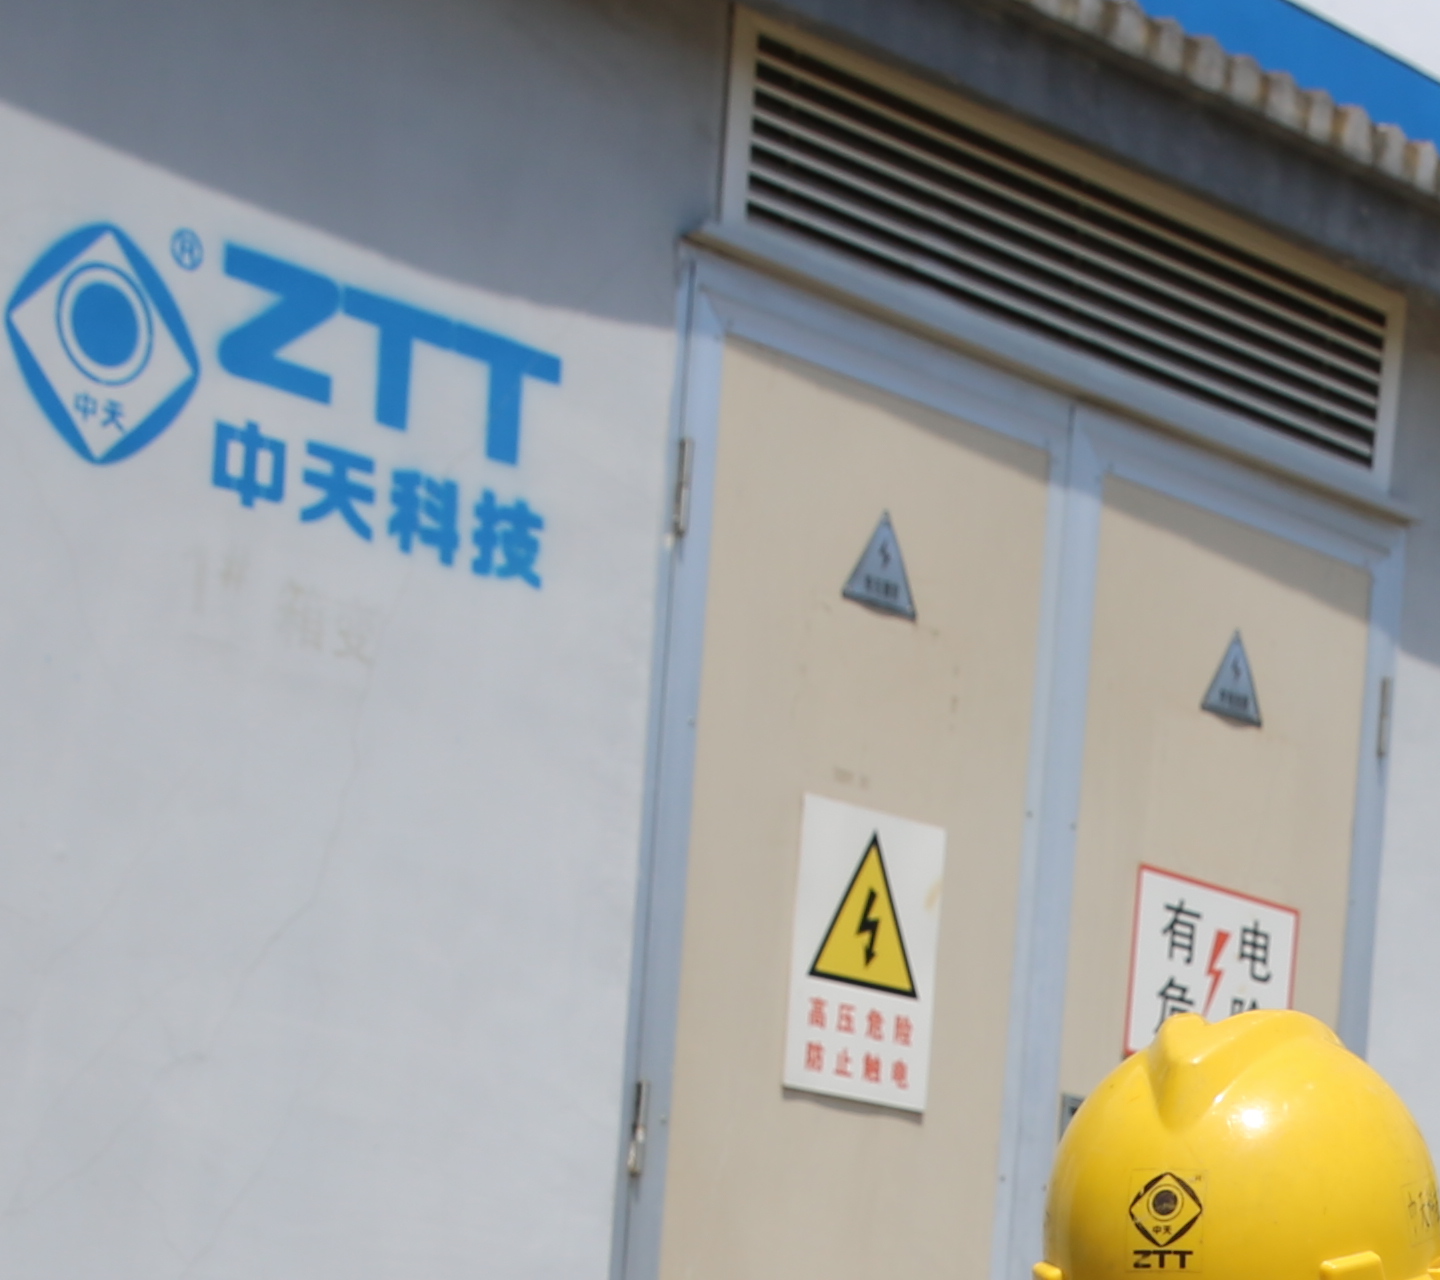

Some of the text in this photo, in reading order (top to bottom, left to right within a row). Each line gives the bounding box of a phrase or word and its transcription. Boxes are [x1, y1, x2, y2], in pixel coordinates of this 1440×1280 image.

[217, 241, 562, 467] ZTT
[73, 391, 126, 433] 中天
[211, 419, 545, 591] 中天科技
[807, 995, 914, 1047] 高压危险
[804, 1041, 911, 1091] 防止触电
[1152, 1224, 1172, 1236] 中天
[1133, 1249, 1194, 1270] ZTT
